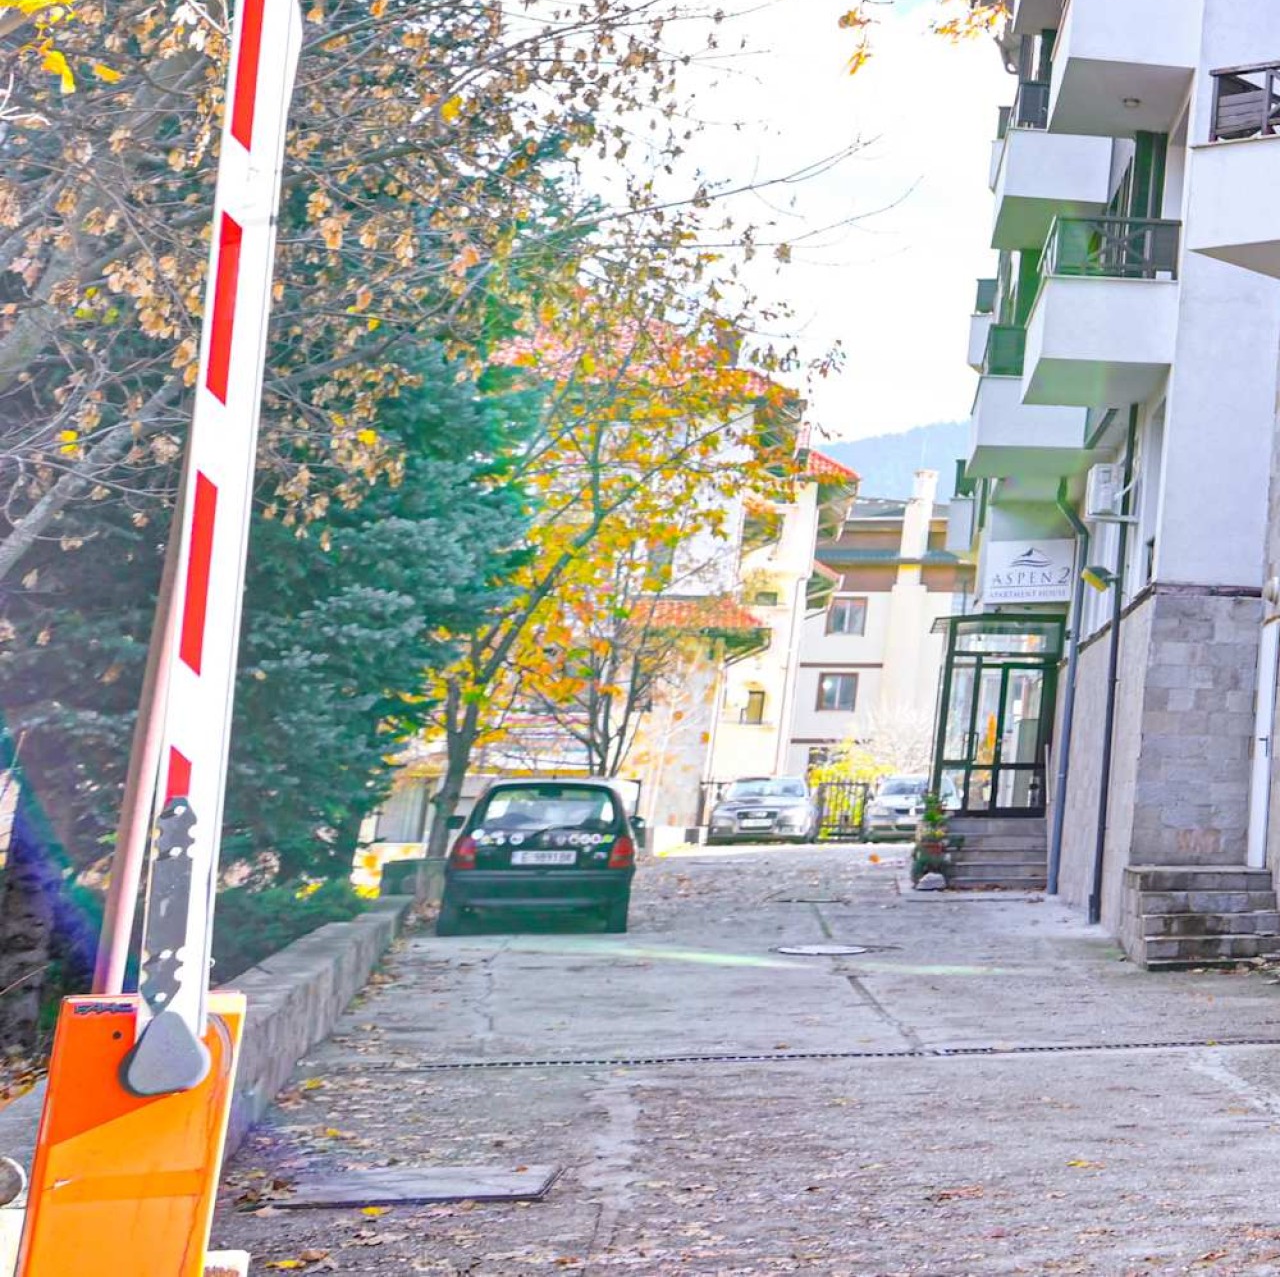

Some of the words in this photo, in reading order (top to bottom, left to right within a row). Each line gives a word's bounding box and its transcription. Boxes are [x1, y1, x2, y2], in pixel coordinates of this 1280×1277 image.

[992, 571, 1053, 586] ASPEN
[1057, 566, 1071, 584] 2
[990, 589, 1037, 598] APARTMENT
[1038, 588, 1066, 597] HOUSE
